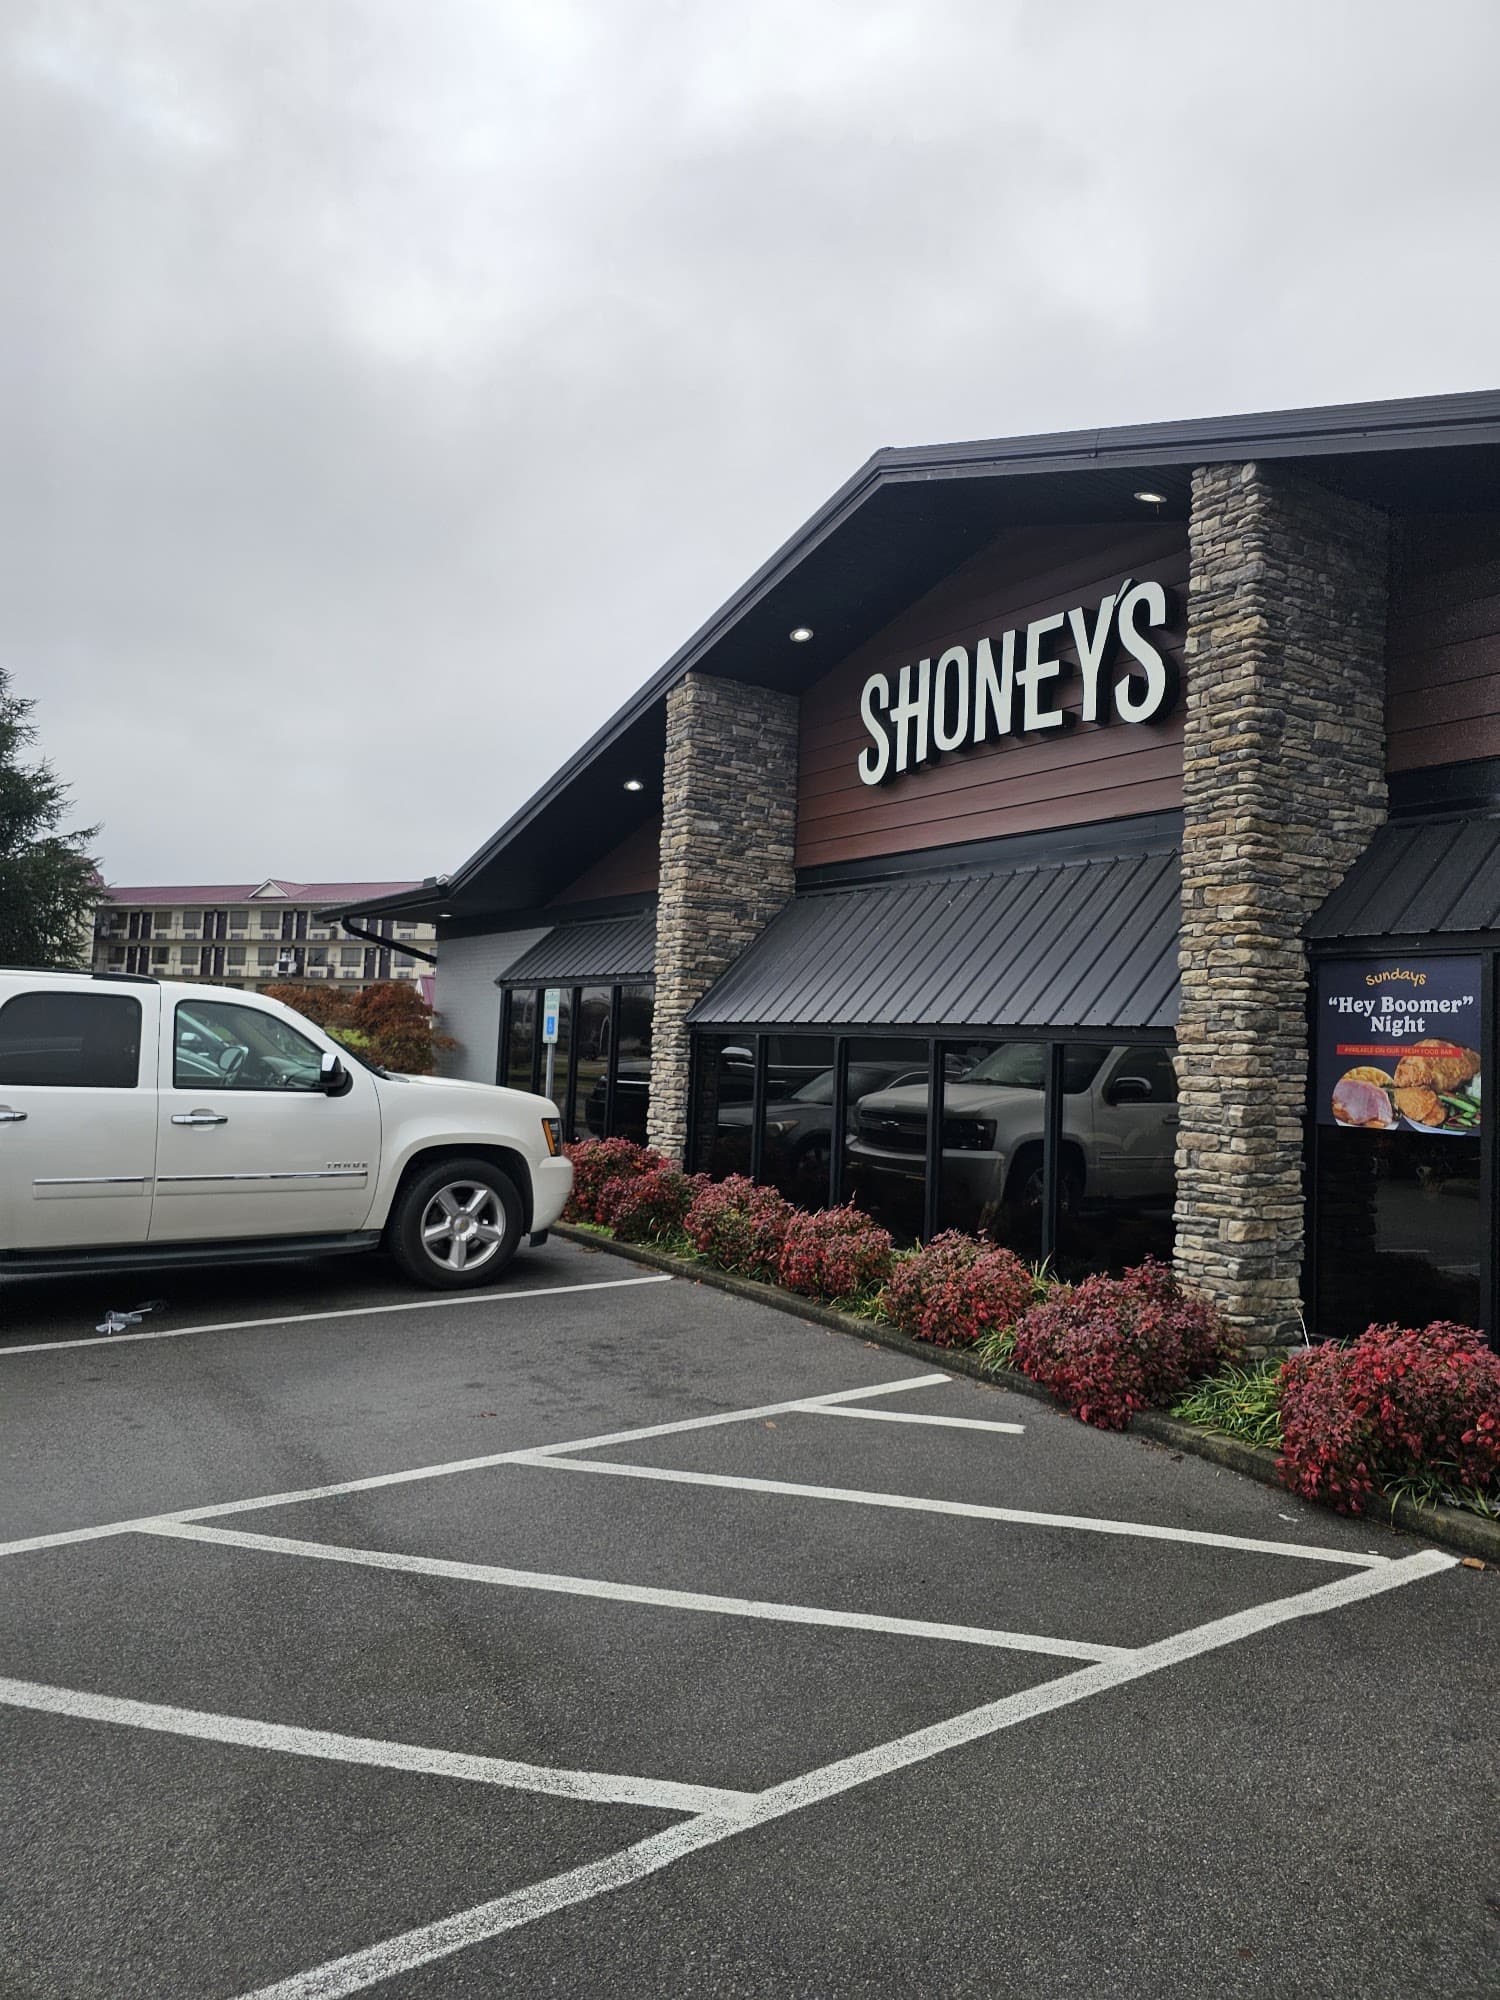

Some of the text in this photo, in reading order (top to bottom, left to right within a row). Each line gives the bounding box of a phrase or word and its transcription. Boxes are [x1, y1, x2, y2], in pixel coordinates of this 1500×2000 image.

[858, 578, 1166, 785] SHONEY'S
[1365, 968, 1427, 987] Sundays
[1370, 1016, 1426, 1037] Night
